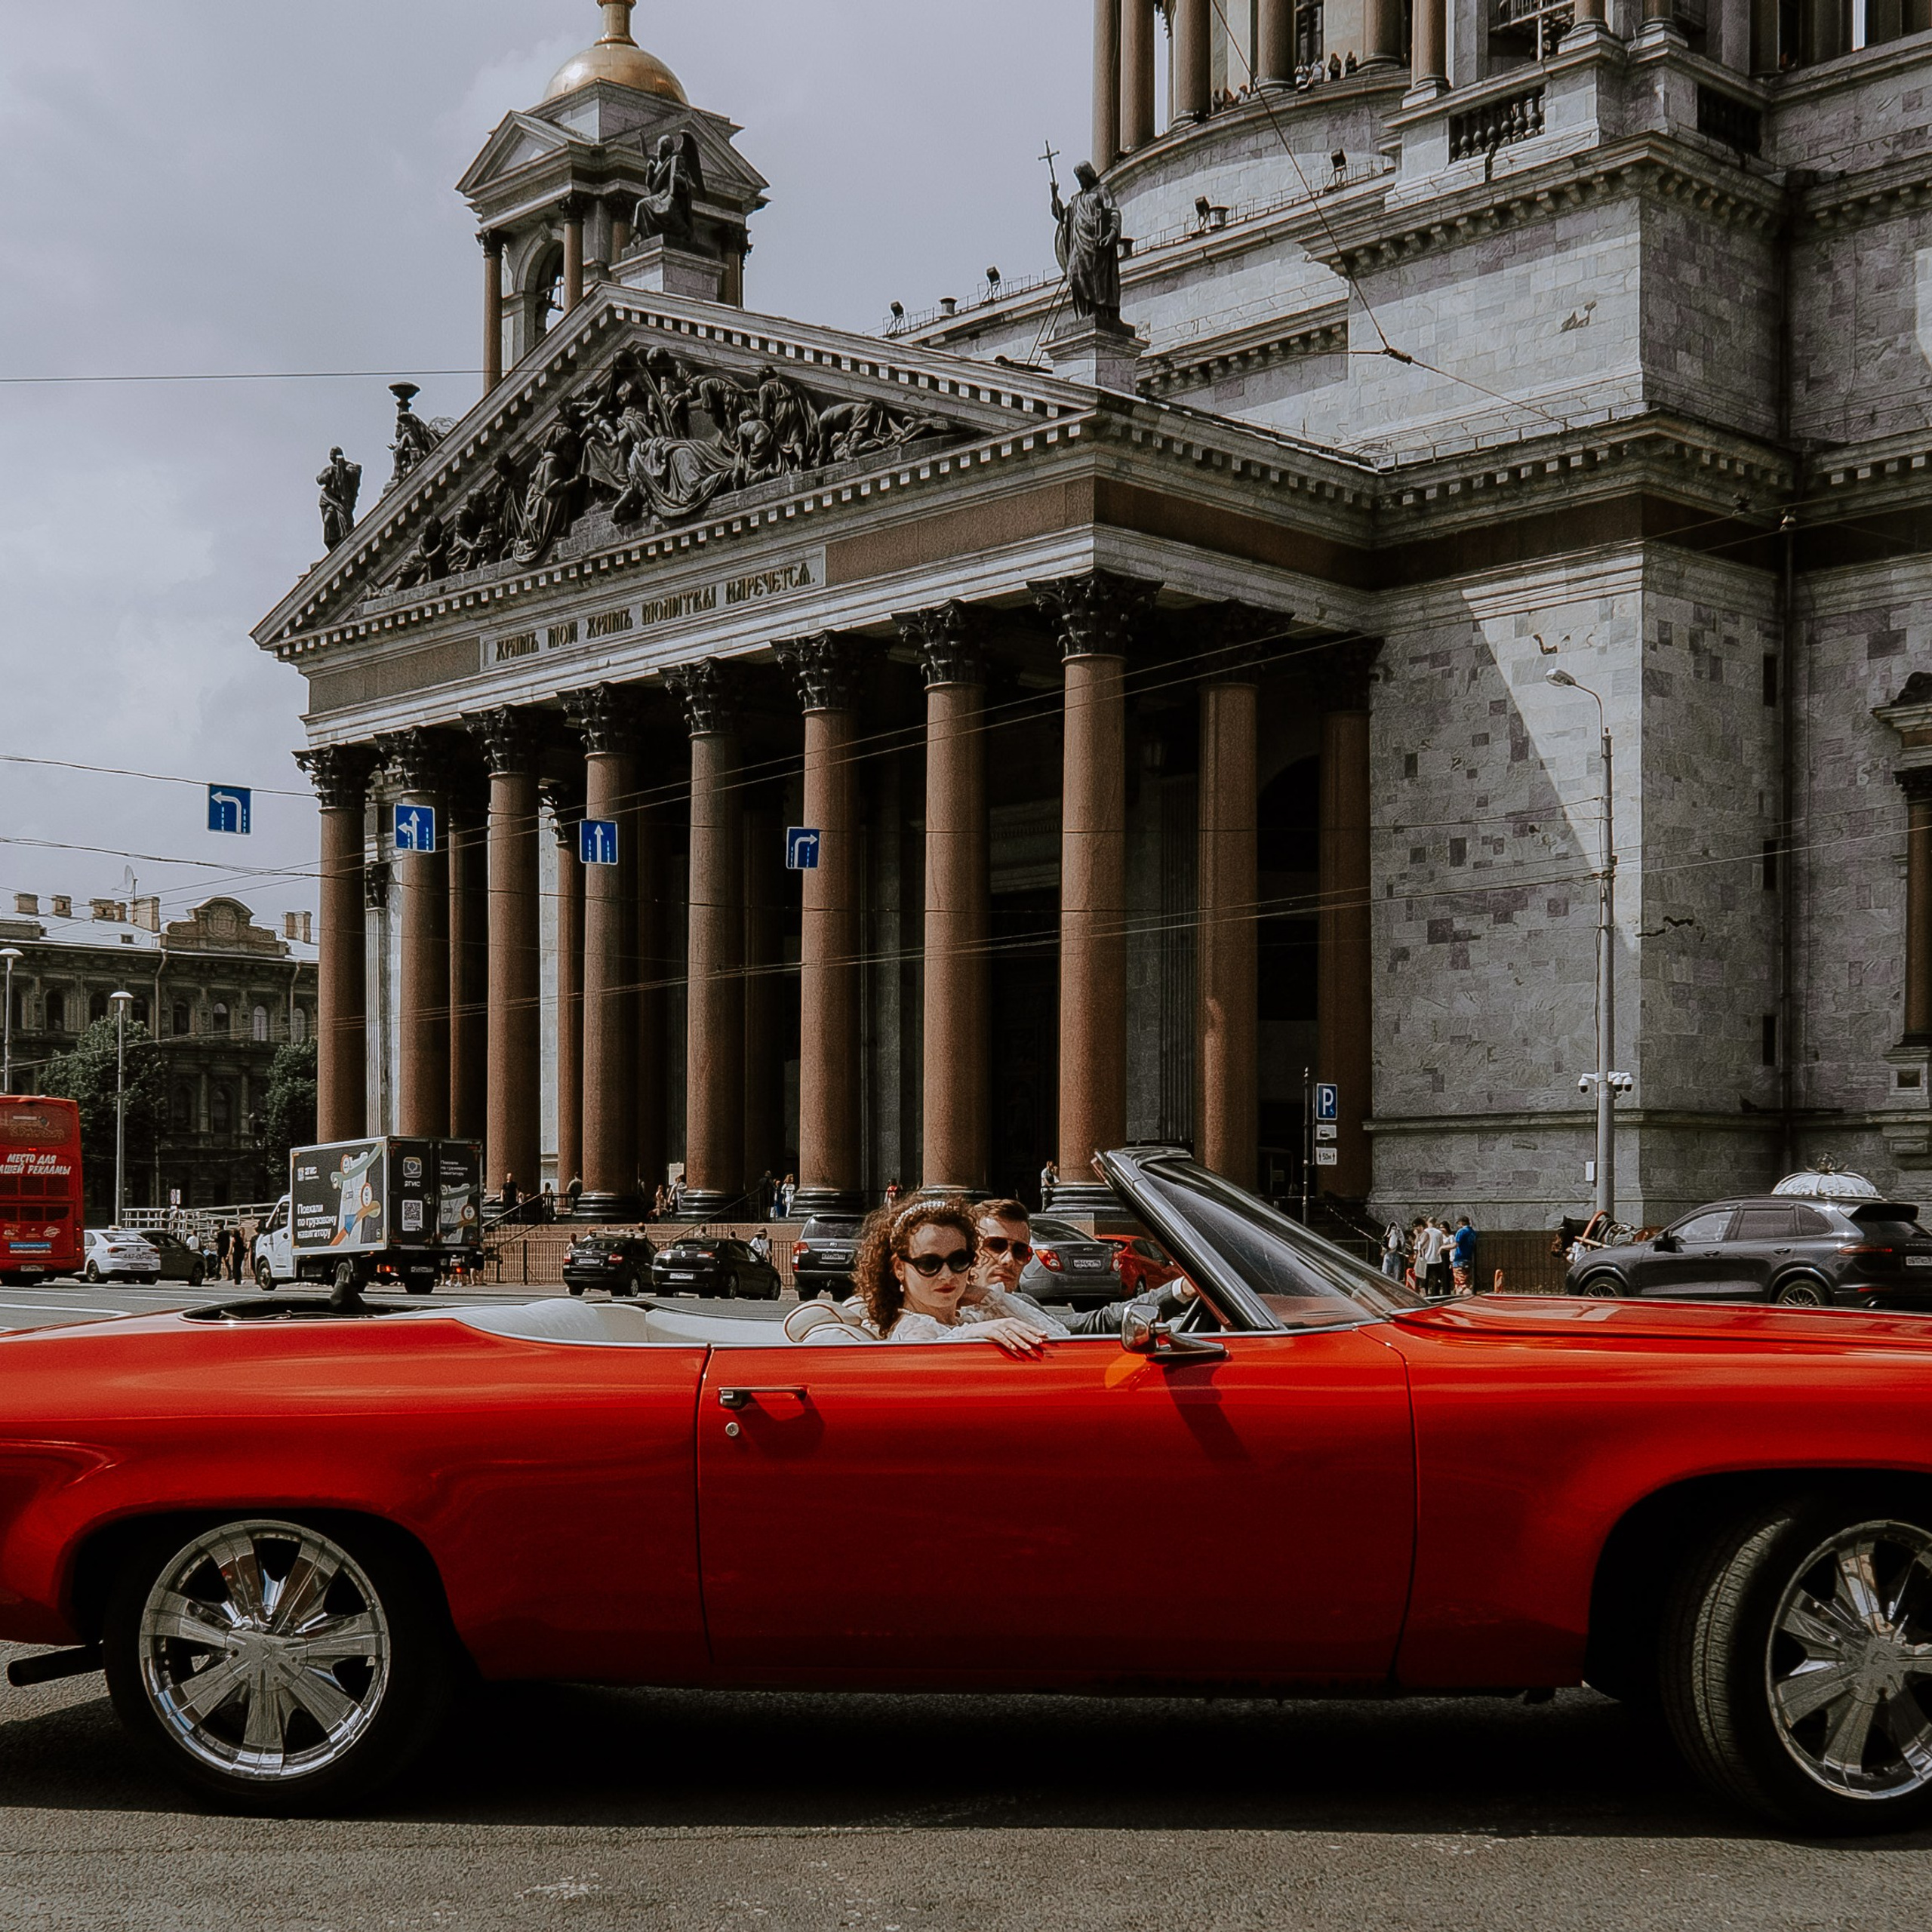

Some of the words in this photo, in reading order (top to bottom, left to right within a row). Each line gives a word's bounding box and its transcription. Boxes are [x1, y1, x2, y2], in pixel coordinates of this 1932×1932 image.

[1322, 1088, 1334, 1115] P
[7, 1153, 36, 1164] МЕСТО
[37, 1154, 57, 1165] ДЛЯ
[0, 1162, 25, 1174] АШЕЙ
